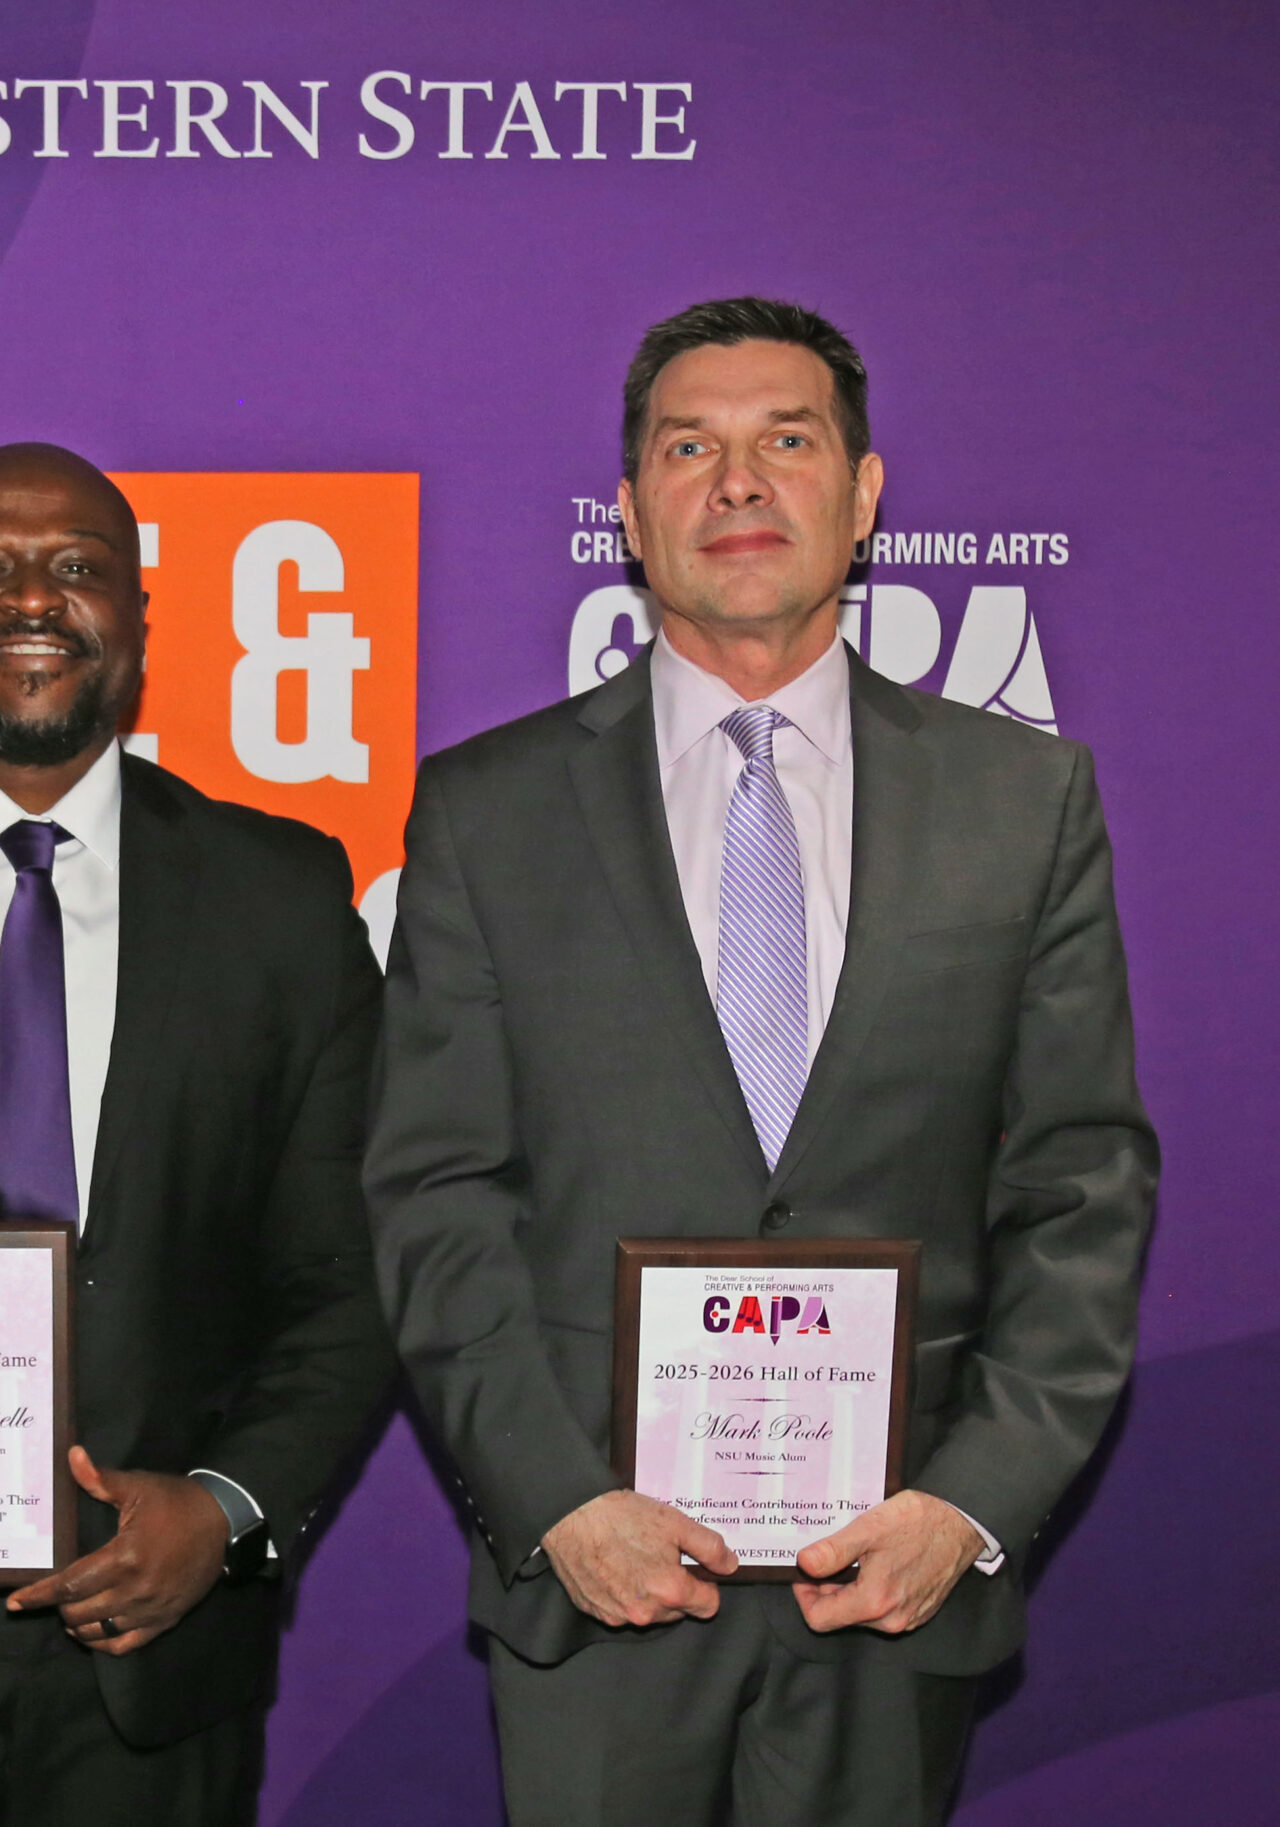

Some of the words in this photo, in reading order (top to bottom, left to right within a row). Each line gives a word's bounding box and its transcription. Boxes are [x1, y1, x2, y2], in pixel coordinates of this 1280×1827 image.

[357, 70, 697, 161] STATE
[571, 498, 623, 523] The
[852, 532, 978, 564] ORMING
[985, 533, 1070, 565] ARTS
[230, 520, 371, 784] &
[704, 1283, 744, 1291] CREATIVE
[747, 1283, 752, 1291] &
[755, 1283, 810, 1292] PERFORMING
[812, 1284, 834, 1292] ARTS
[703, 1296, 831, 1346] CAPA
[654, 1364, 754, 1380] 2025-2026
[761, 1366, 798, 1381] Hall
[804, 1366, 824, 1381] of
[829, 1367, 876, 1382] Fame
[690, 1411, 762, 1441] Mark
[768, 1413, 833, 1441] Poole
[714, 1451, 742, 1461] NSU
[745, 1451, 776, 1461] Music
[778, 1452, 807, 1462] Alum
[7, 1494, 40, 1505] Their
[675, 1497, 738, 1509] Significant
[741, 1498, 818, 1510] Contribution
[821, 1501, 833, 1510] to
[836, 1500, 871, 1510] Their
[689, 1514, 740, 1524] ofession
[744, 1514, 765, 1525] and
[769, 1515, 788, 1525] the
[790, 1514, 836, 1526] School"
[733, 1549, 796, 1558] WESTERN
